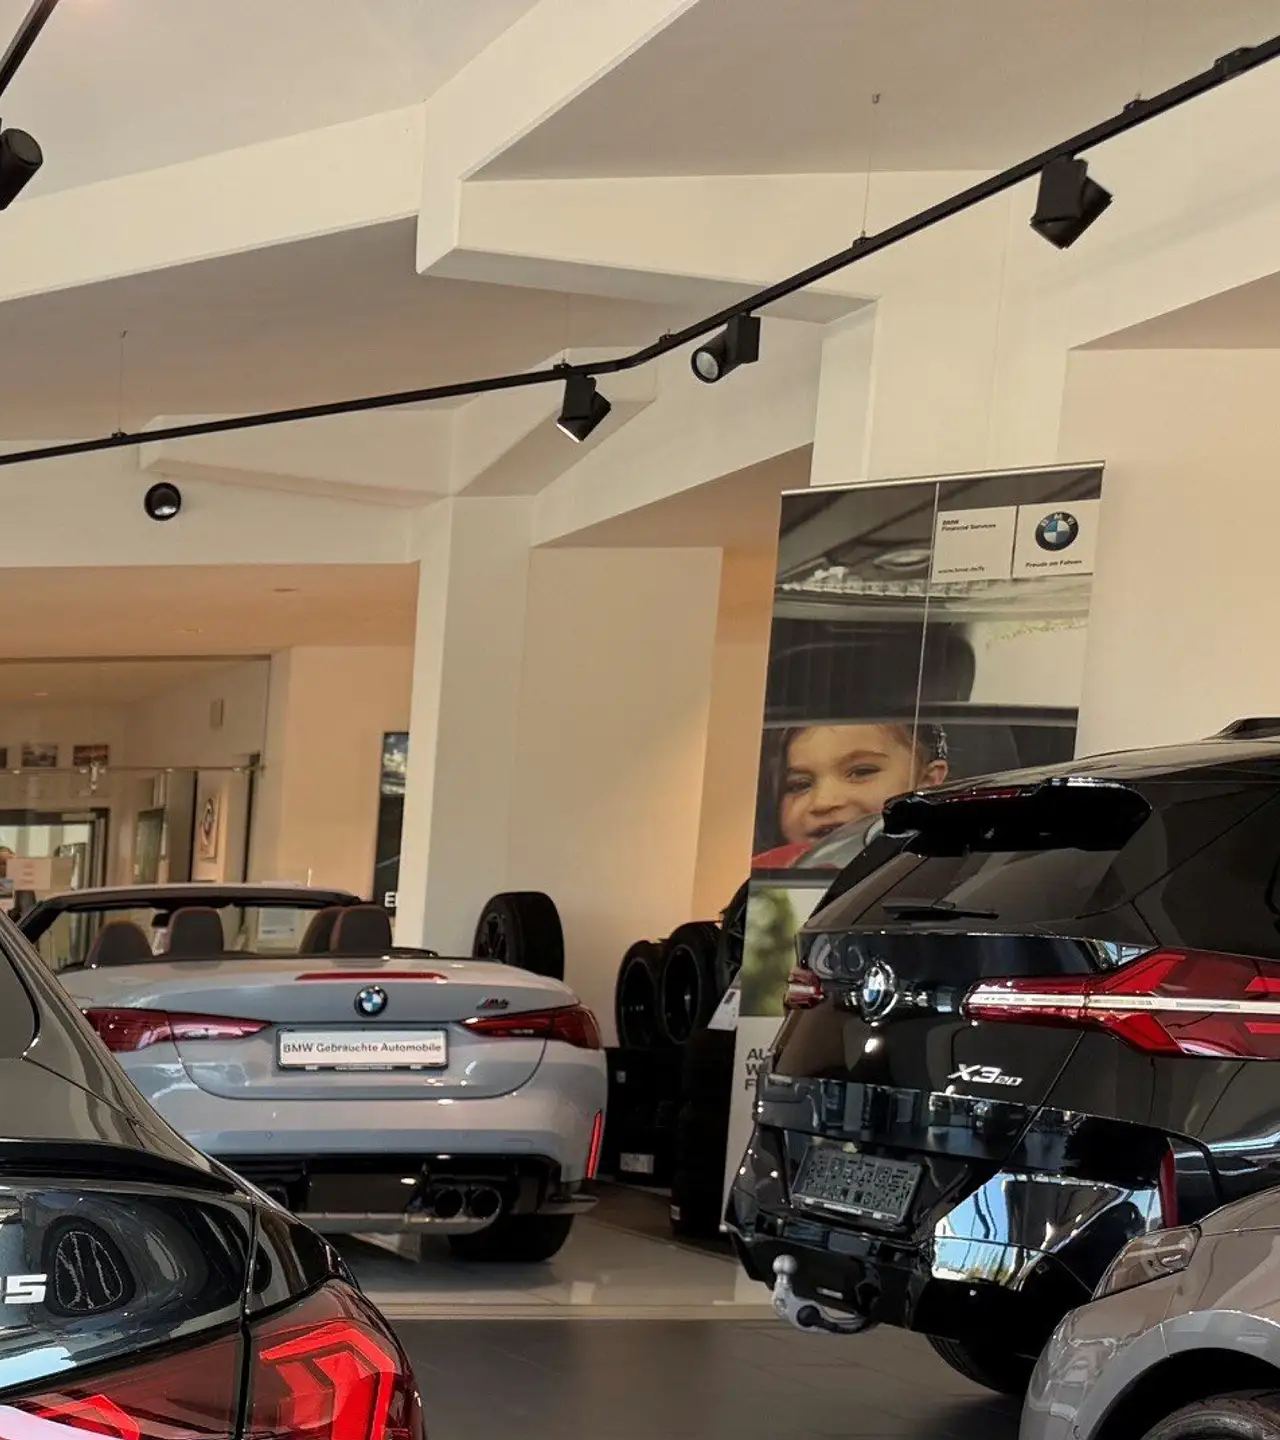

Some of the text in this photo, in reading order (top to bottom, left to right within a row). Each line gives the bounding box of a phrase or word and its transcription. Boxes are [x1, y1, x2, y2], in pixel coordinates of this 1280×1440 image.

[283, 1041, 442, 1054] BMW Gebrauchte Automobile
